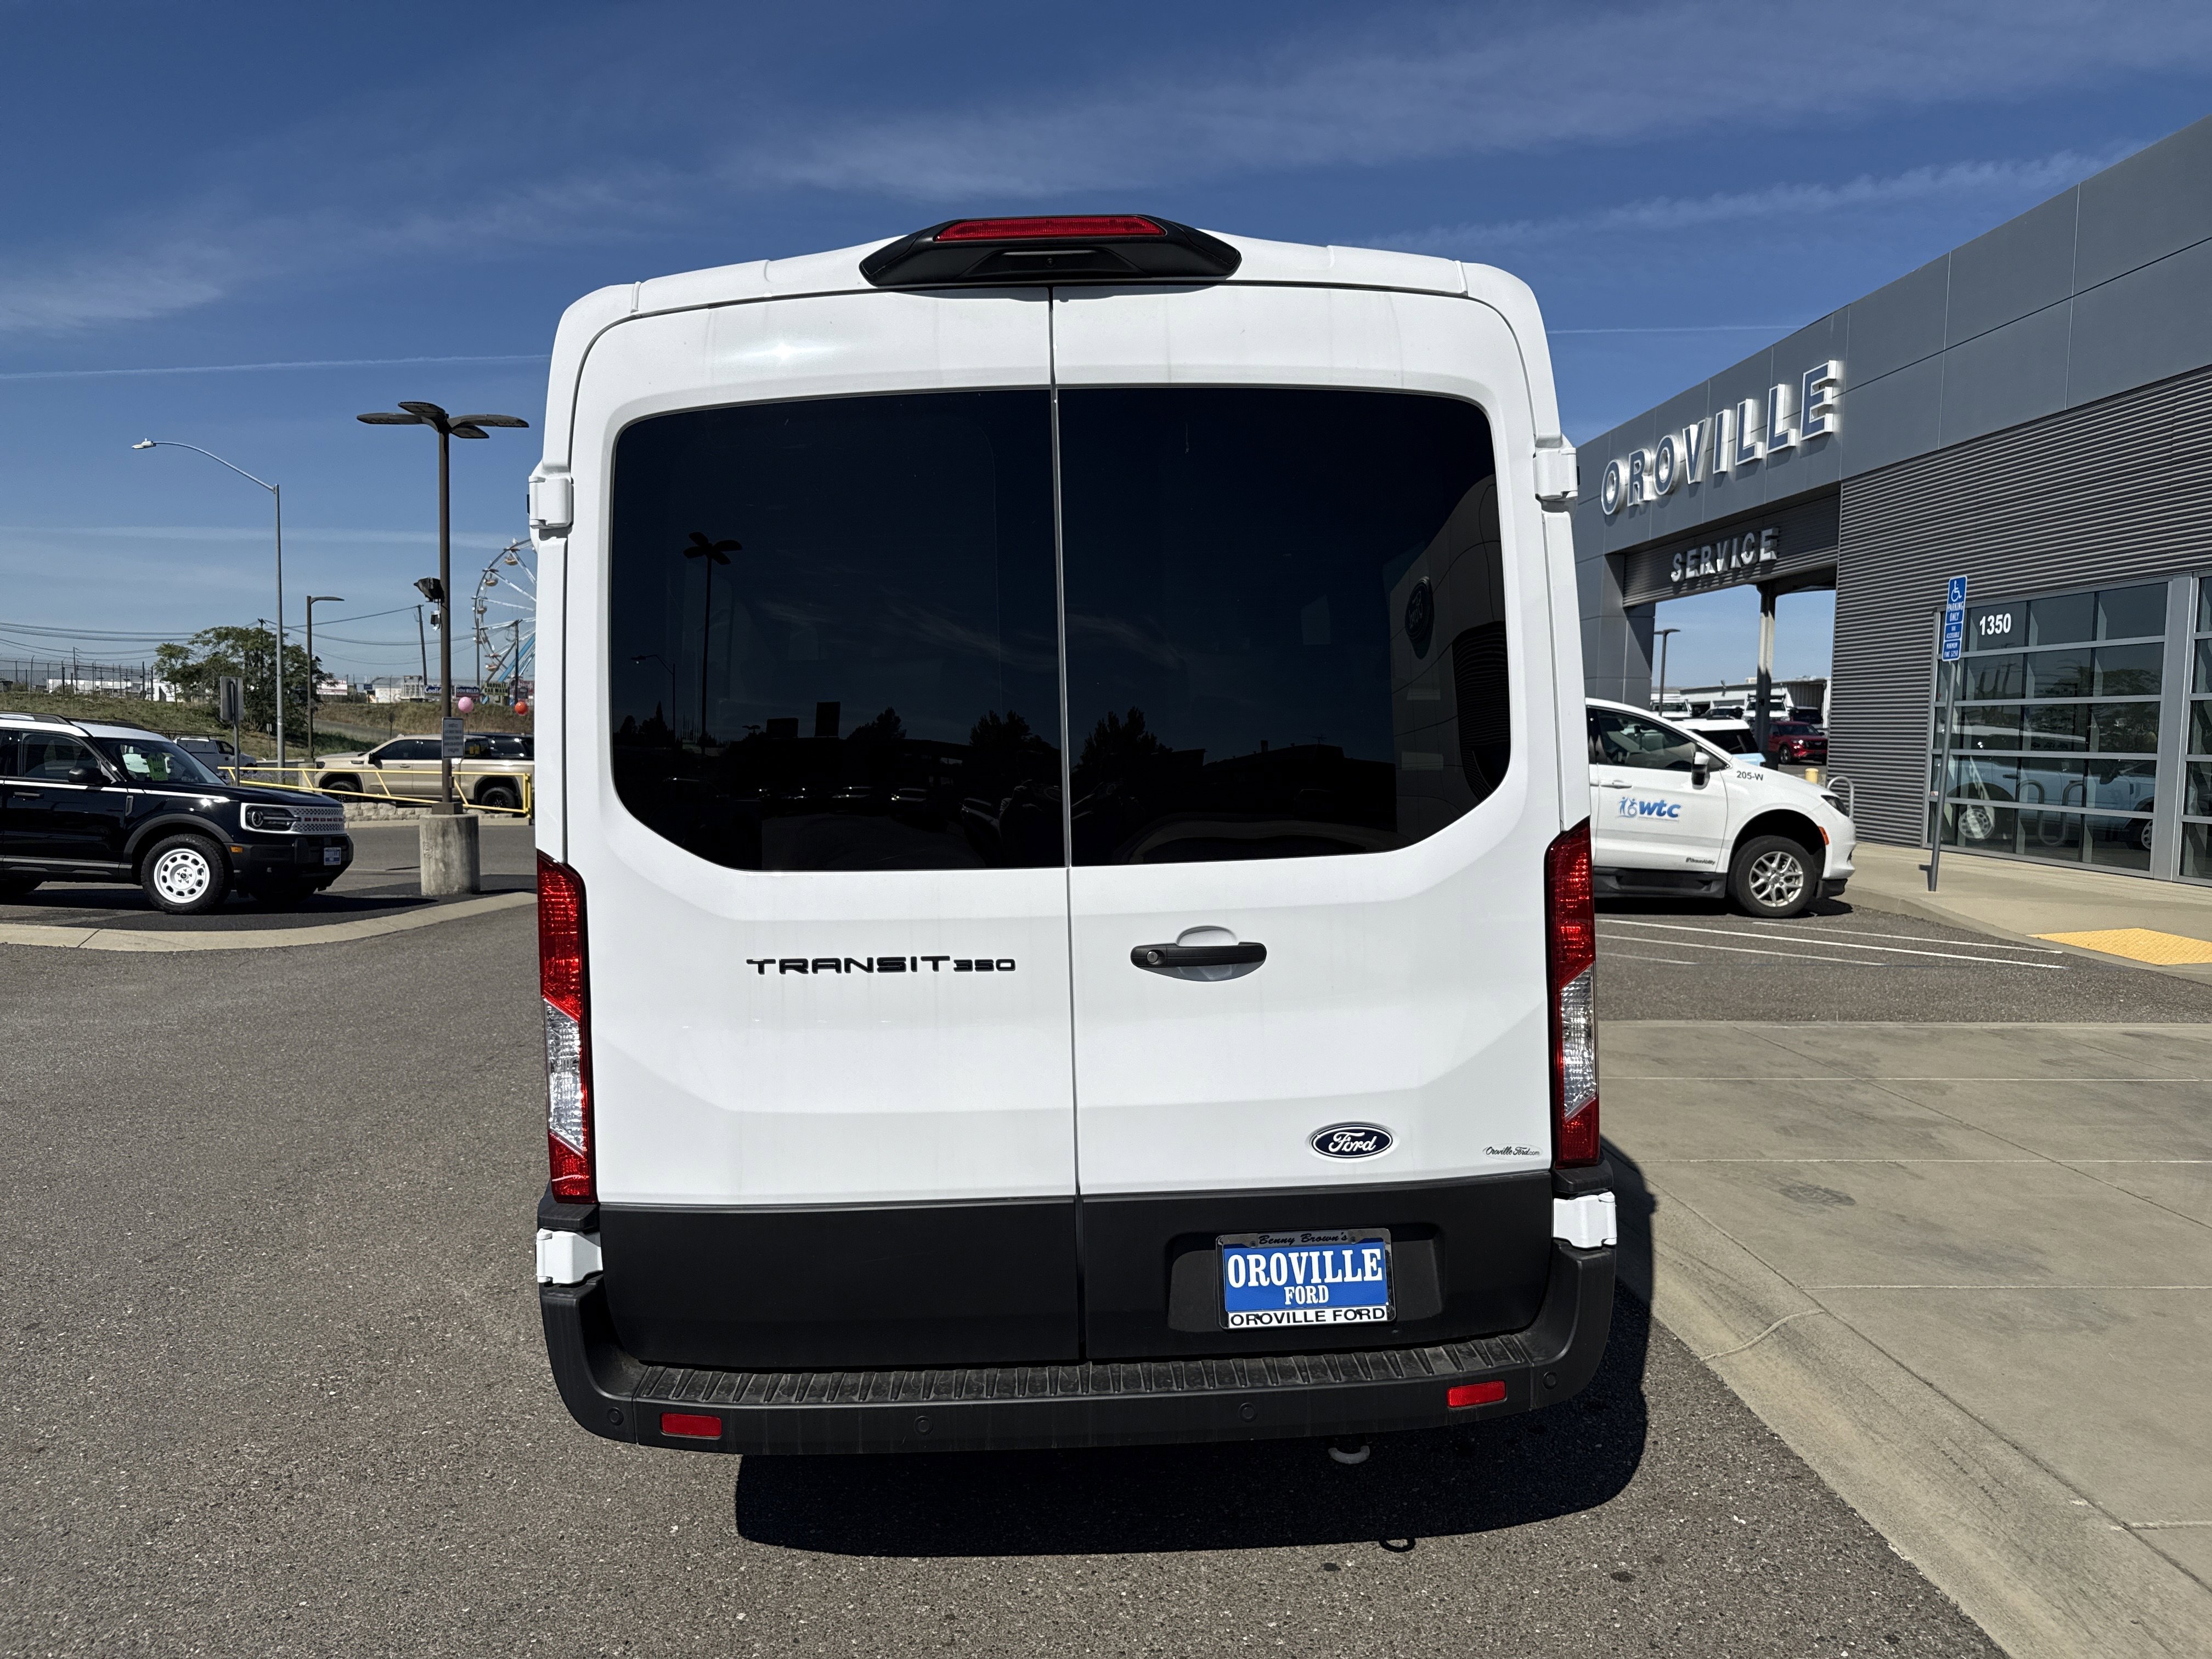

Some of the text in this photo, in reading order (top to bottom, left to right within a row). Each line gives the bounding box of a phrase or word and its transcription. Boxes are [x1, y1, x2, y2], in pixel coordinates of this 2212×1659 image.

[1601, 360, 1837, 516] OROVILLE
[1671, 527, 1779, 583] SERVICE
[1948, 601, 1964, 612] PARKING
[1949, 612, 1960, 622] ONLY
[1979, 613, 2011, 635] 1350
[1736, 771, 1763, 781] 205-W
[1639, 800, 1681, 818] wtc
[746, 956, 1015, 974] TRANSIT 350
[1328, 1131, 1378, 1152] Ford
[1483, 1146, 1513, 1155] Oroville
[1259, 1232, 1348, 1245] Benny Brown's
[1228, 1248, 1383, 1288] OROVILLE
[1284, 1285, 1329, 1305] FORD
[1231, 1308, 1385, 1327] OROVILLE FORD
